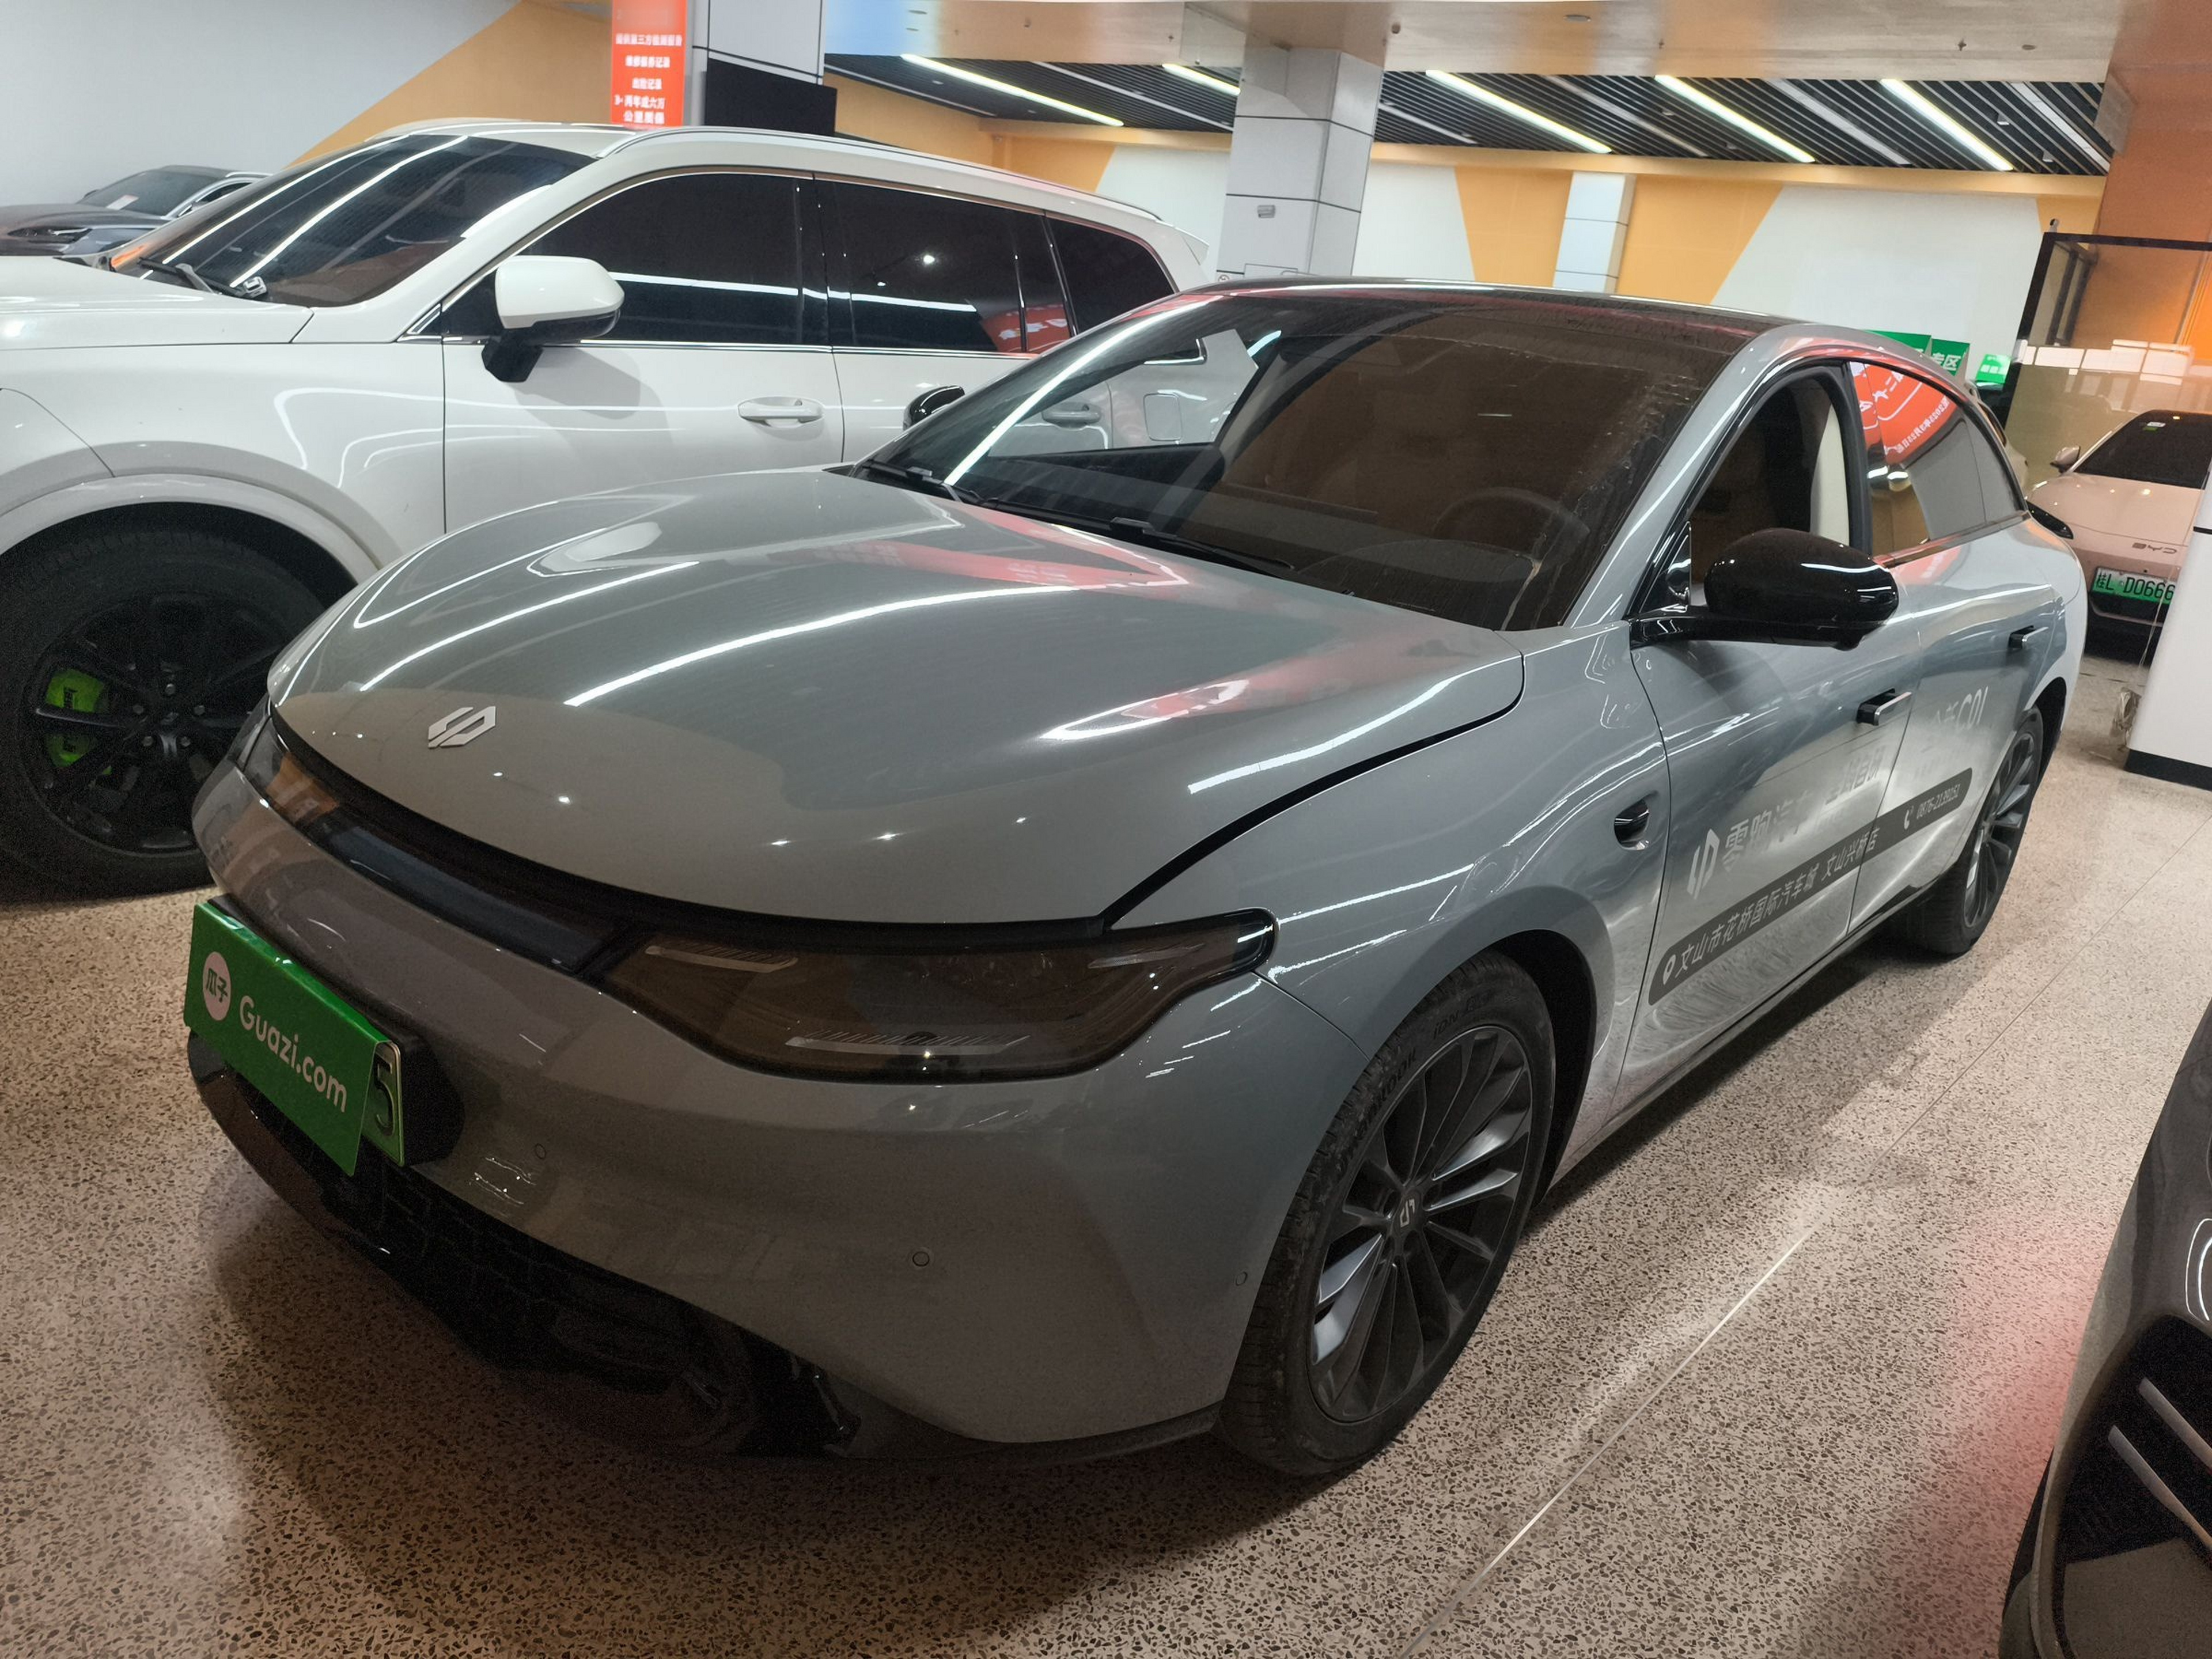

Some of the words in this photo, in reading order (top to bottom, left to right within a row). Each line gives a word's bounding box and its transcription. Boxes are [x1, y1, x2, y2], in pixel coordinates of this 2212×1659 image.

[2132, 542, 2177, 554] BYD
[206, 967, 228, 1003] 瓜子
[239, 995, 347, 1113] Guazi.com
